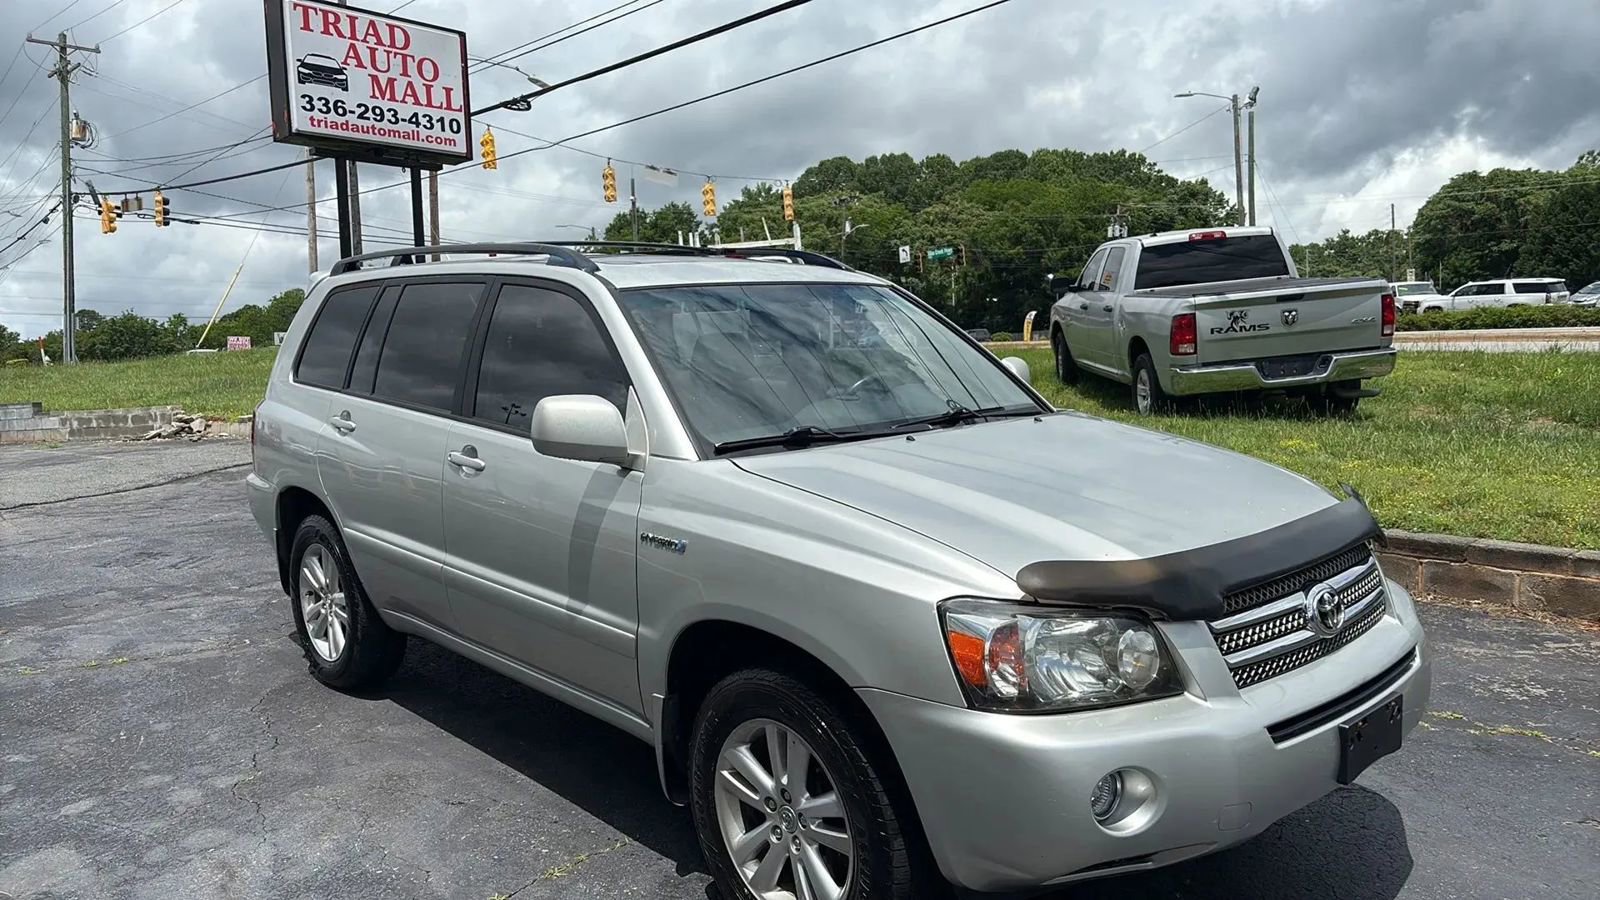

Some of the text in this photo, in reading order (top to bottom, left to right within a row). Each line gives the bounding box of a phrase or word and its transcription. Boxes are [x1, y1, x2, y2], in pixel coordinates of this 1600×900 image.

[293, 3, 411, 51] TRIAD
[341, 43, 440, 83] AUTO
[368, 74, 463, 113] MALL
[300, 93, 462, 135] 336-293-4310
[308, 115, 457, 147] triadautomall.com
[1210, 323, 1271, 335] RAMS
